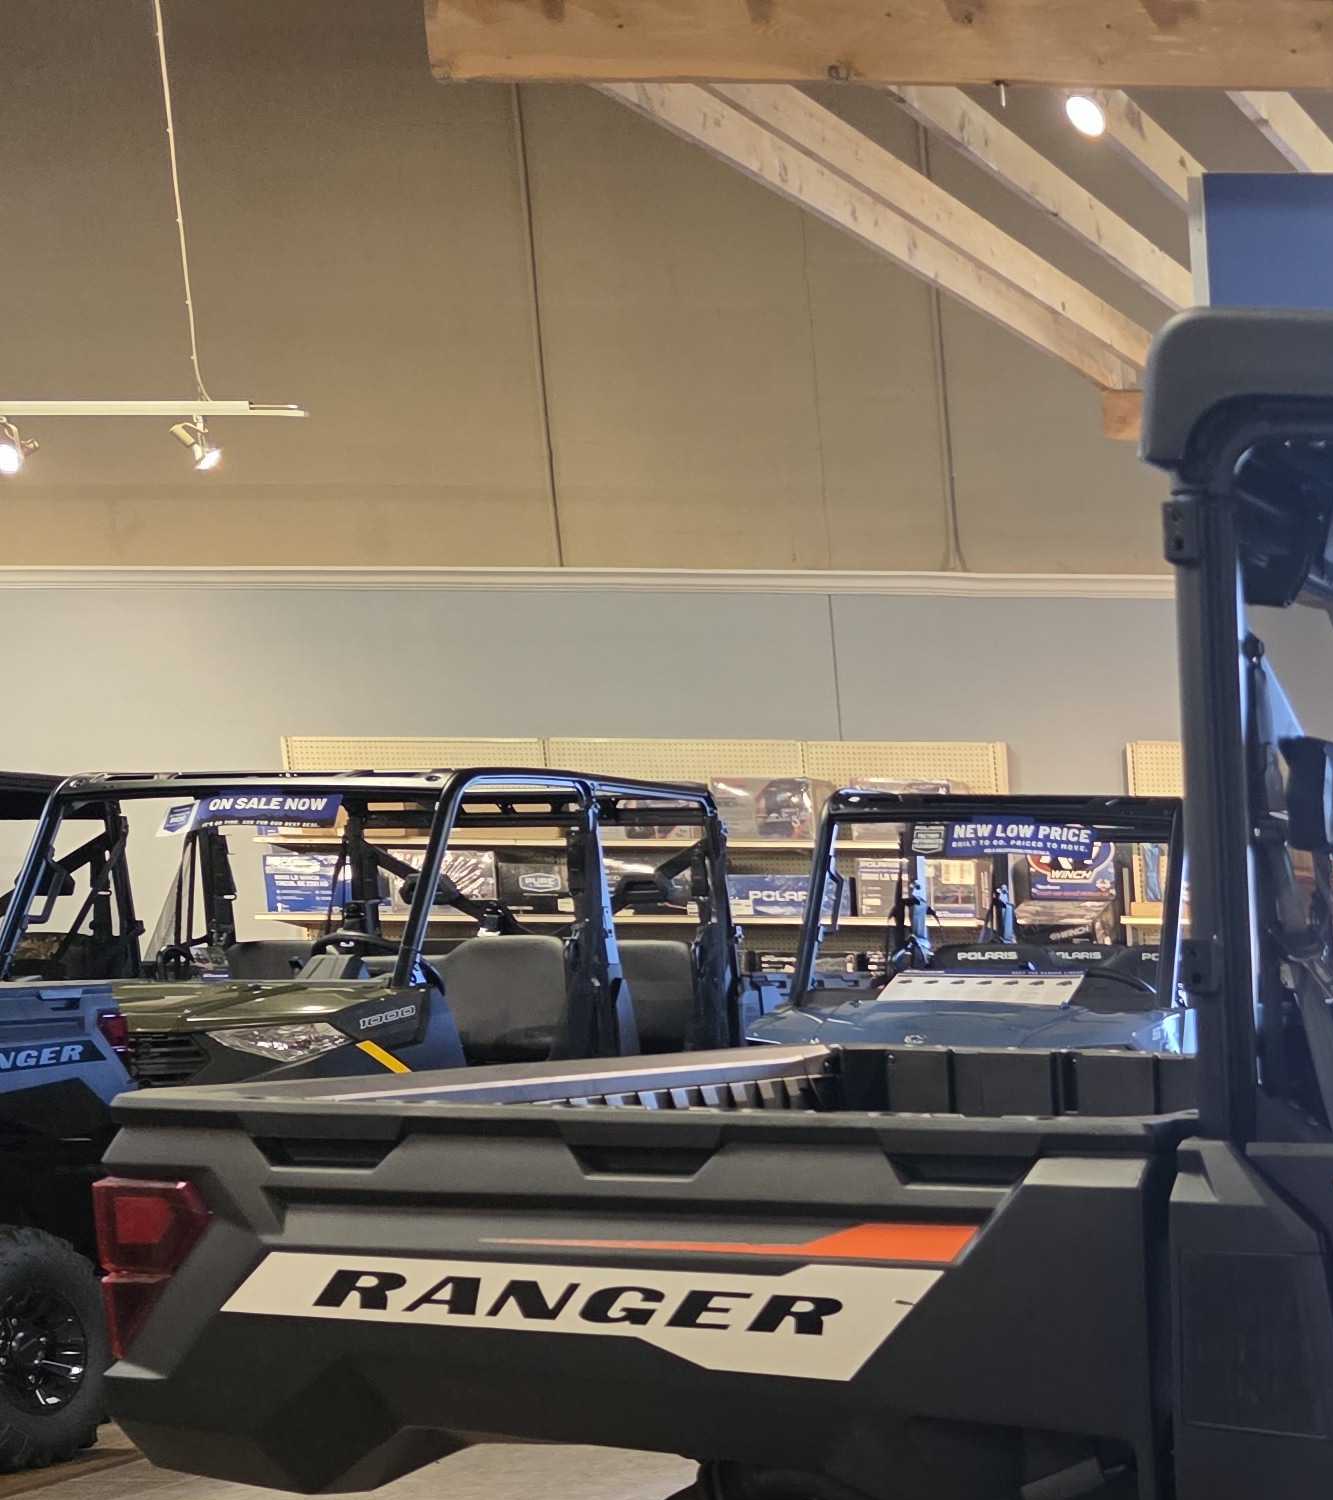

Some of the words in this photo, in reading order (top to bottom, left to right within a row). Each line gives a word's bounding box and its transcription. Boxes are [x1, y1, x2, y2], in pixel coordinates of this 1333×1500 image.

[208, 798, 233, 811] ON
[234, 797, 283, 811] SALE
[284, 798, 328, 811] NOW
[953, 824, 992, 839] NEW
[995, 824, 1035, 839] LOW
[1038, 826, 1092, 843] PRICE
[1050, 869, 1092, 879] WINCH
[957, 951, 1019, 960] POLARIS
[359, 1005, 416, 1030] 1000
[313, 1268, 844, 1336] RANGER
